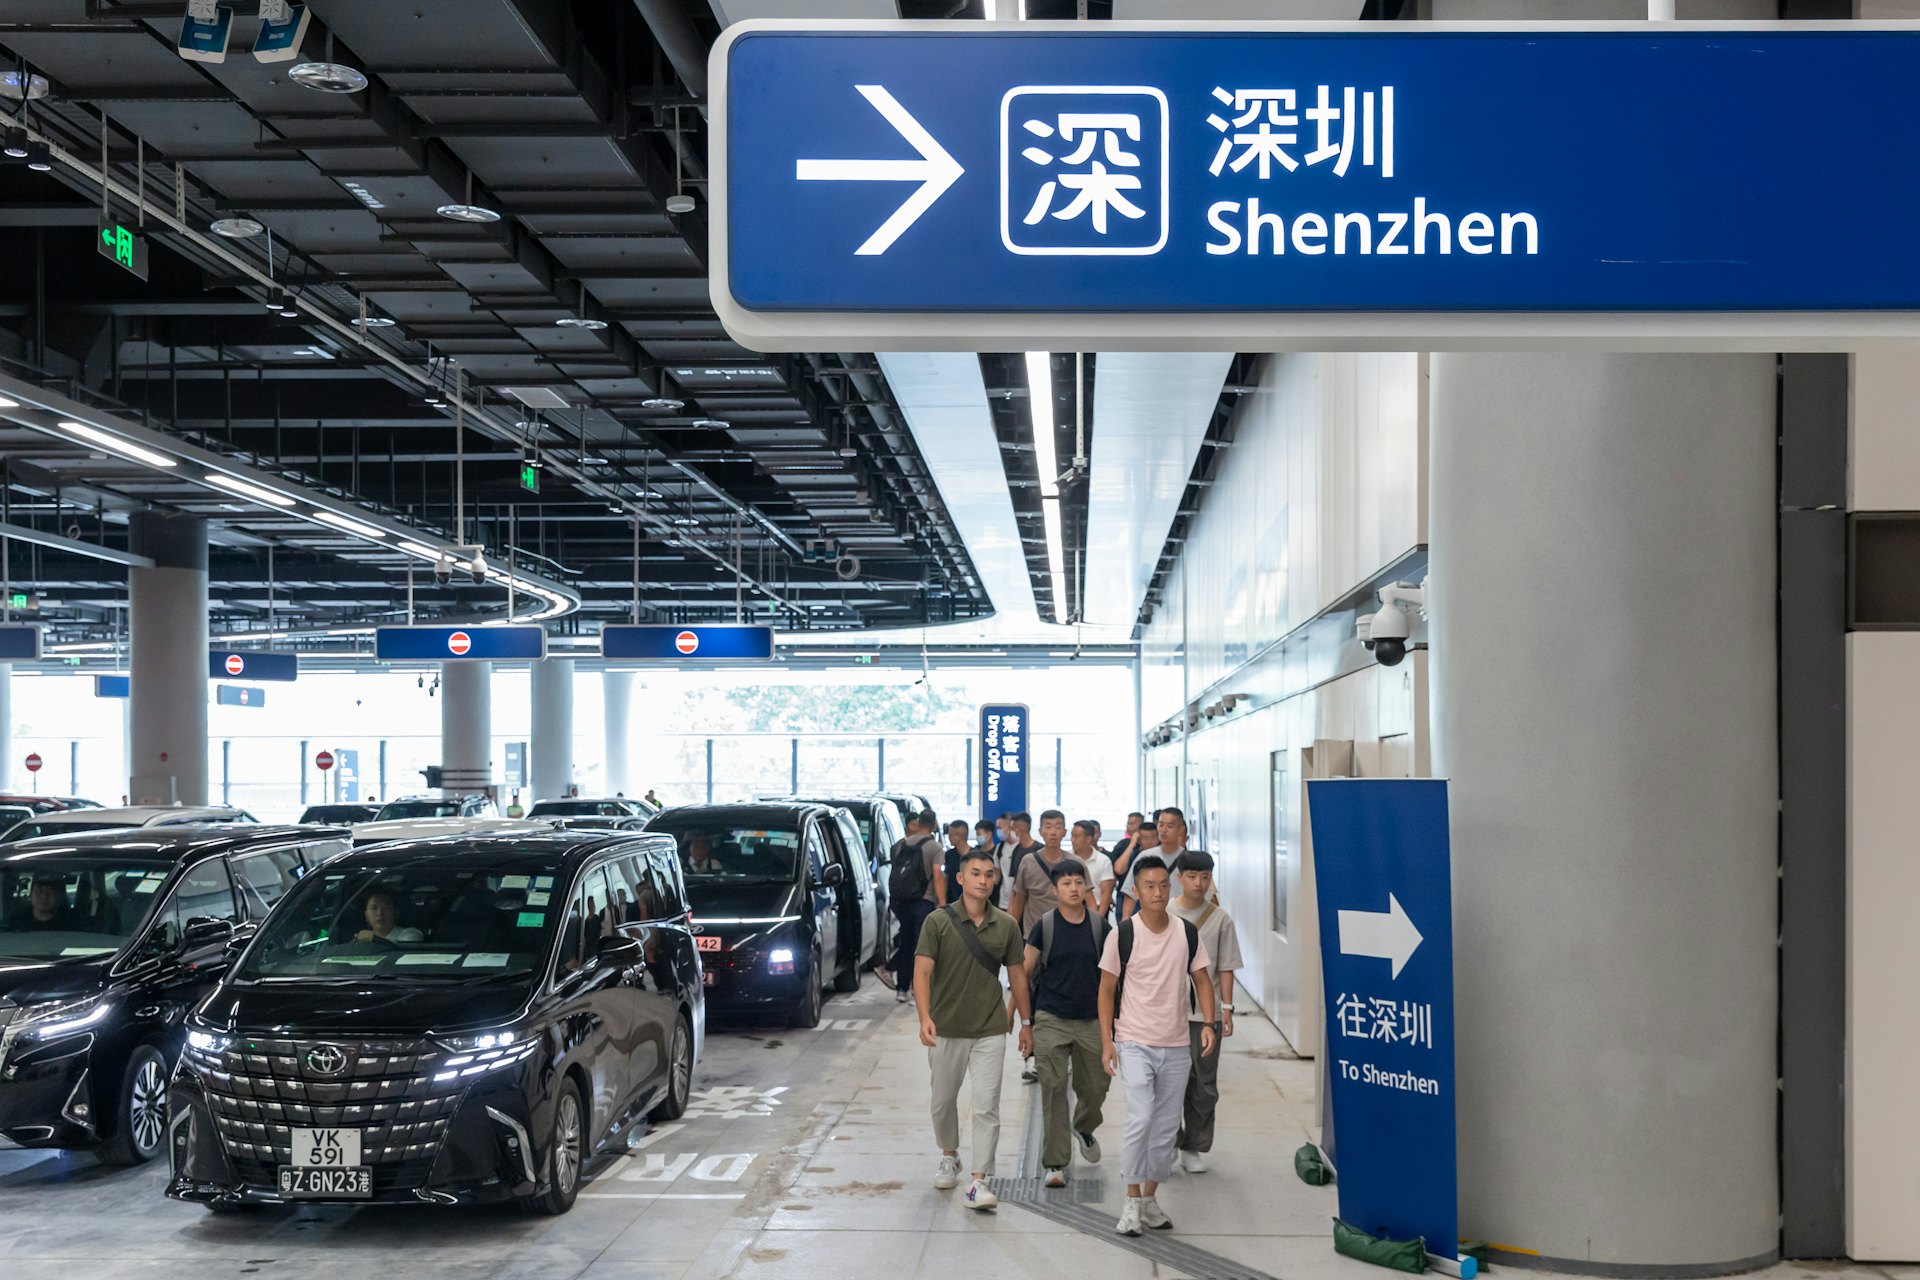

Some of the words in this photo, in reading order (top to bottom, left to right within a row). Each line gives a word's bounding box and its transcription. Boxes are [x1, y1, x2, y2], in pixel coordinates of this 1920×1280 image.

[1206, 84, 1395, 180] 深圳
[1021, 112, 1147, 235] 深
[1206, 196, 1539, 256] Shenzhen
[985, 714, 1001, 747] Drop
[987, 748, 1001, 771] Off
[987, 770, 1001, 802] Area
[1336, 992, 1433, 1050] 往深圳
[1338, 1059, 1360, 1081] To
[1362, 1062, 1439, 1096] Shenzhen
[312, 1129, 340, 1147] VK
[309, 1147, 343, 1165] 591
